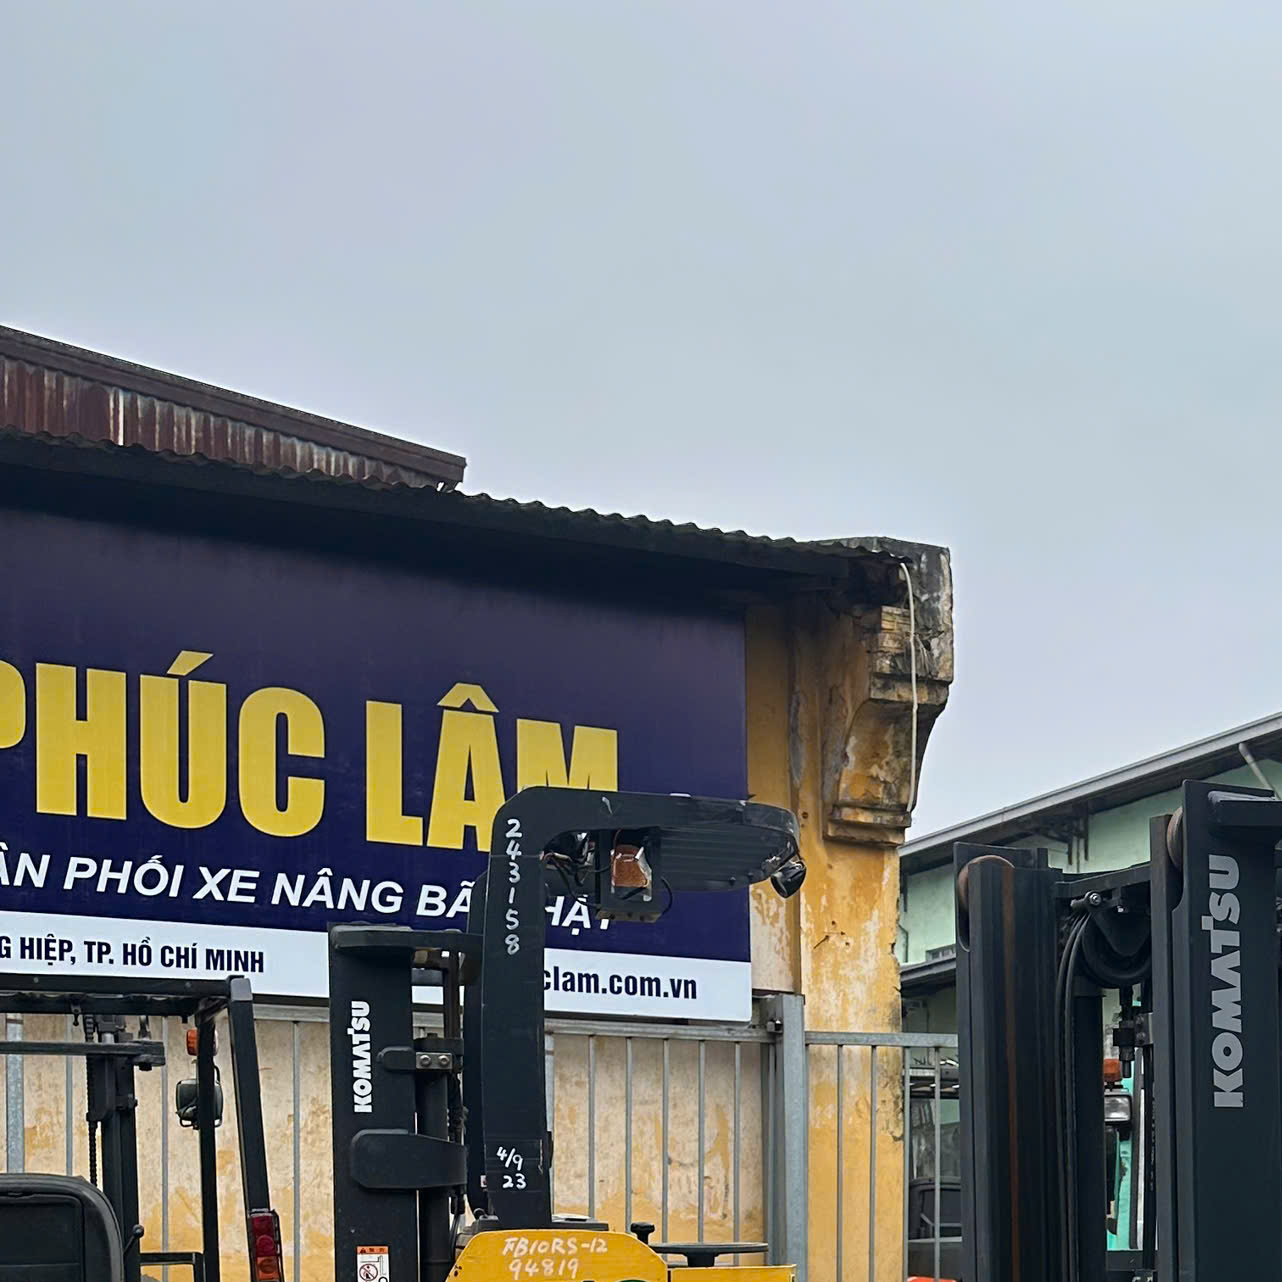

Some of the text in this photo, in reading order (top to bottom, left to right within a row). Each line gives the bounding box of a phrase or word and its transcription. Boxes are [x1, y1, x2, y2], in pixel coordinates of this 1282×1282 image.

[0, 841, 50, 888] N
[63, 854, 184, 898] PHỐI
[192, 865, 260, 903] XE
[271, 867, 404, 914] NÂNG
[20, 933, 76, 966] HIỆP,
[84, 940, 114, 964] TP.
[122, 936, 152, 967] HỒ
[160, 942, 197, 970] CHÍ
[205, 948, 264, 973] MINH
[1201, 854, 1244, 1108] KOMATSU
[347, 1000, 373, 1113] KOMATSU
[502, 1172, 527, 1189] 23
[509, 1258, 578, 1281] 94819
